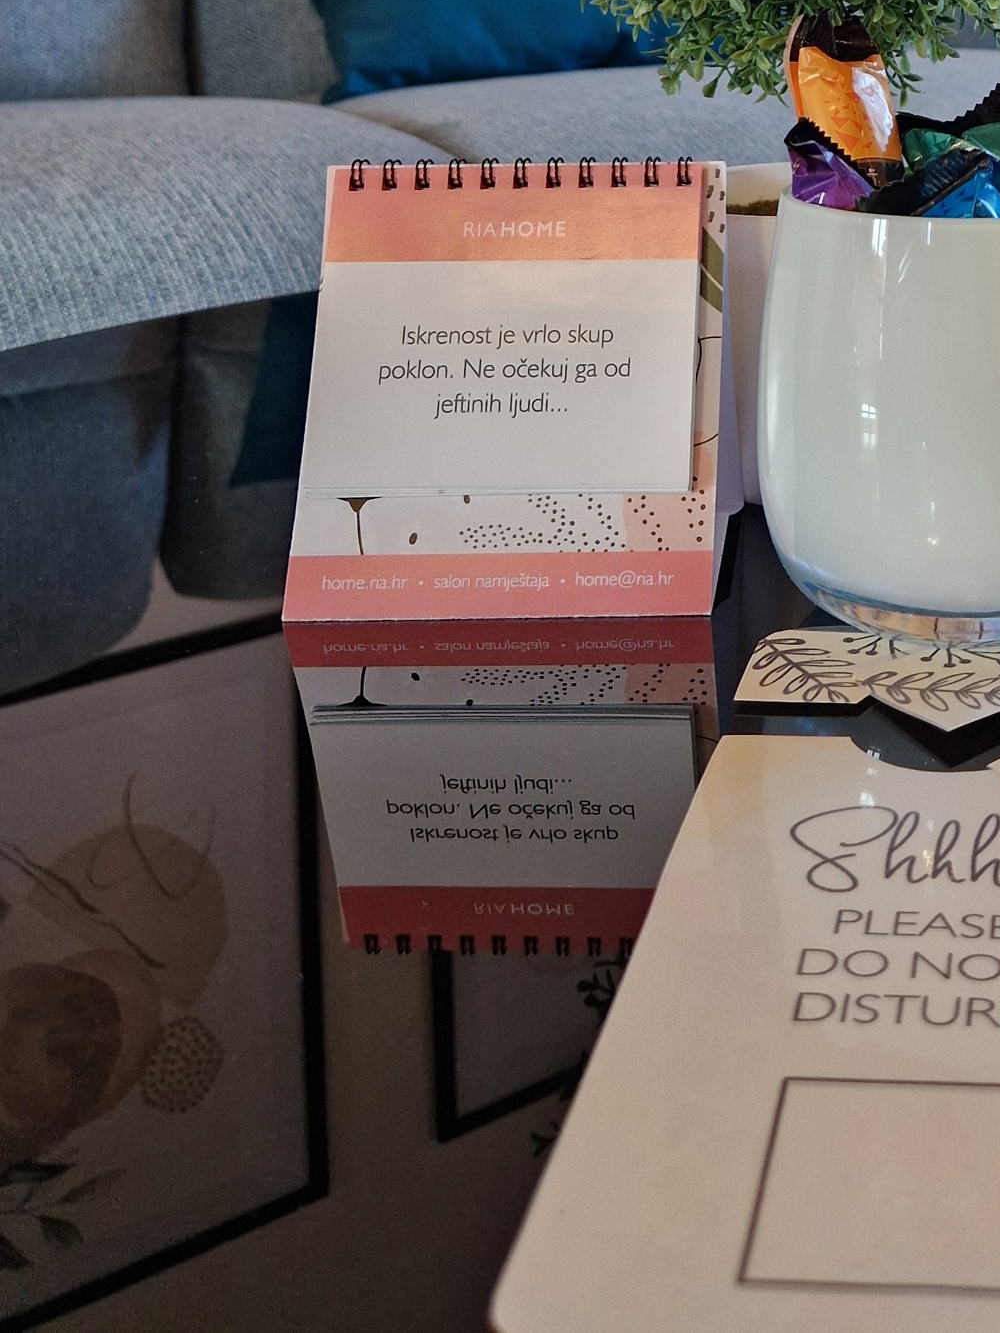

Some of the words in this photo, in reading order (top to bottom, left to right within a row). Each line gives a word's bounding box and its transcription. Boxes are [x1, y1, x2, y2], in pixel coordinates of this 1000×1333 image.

[400, 324, 492, 347] Iskrenost
[496, 324, 516, 350] je
[521, 323, 562, 345] vrlo
[567, 322, 615, 349] skup
[378, 359, 454, 385] poklon.
[462, 359, 496, 379] Ne
[501, 357, 570, 383] očekuj
[575, 364, 599, 384] ga
[604, 357, 632, 378] od
[433, 393, 502, 419] jeftinih
[508, 392, 569, 419] ljudi...
[321, 574, 409, 591] home.ria.hr
[433, 573, 471, 589] salon
[475, 572, 550, 592] namještaja
[575, 570, 675, 589] home@ria.hr
[795, 947, 890, 977] DO
